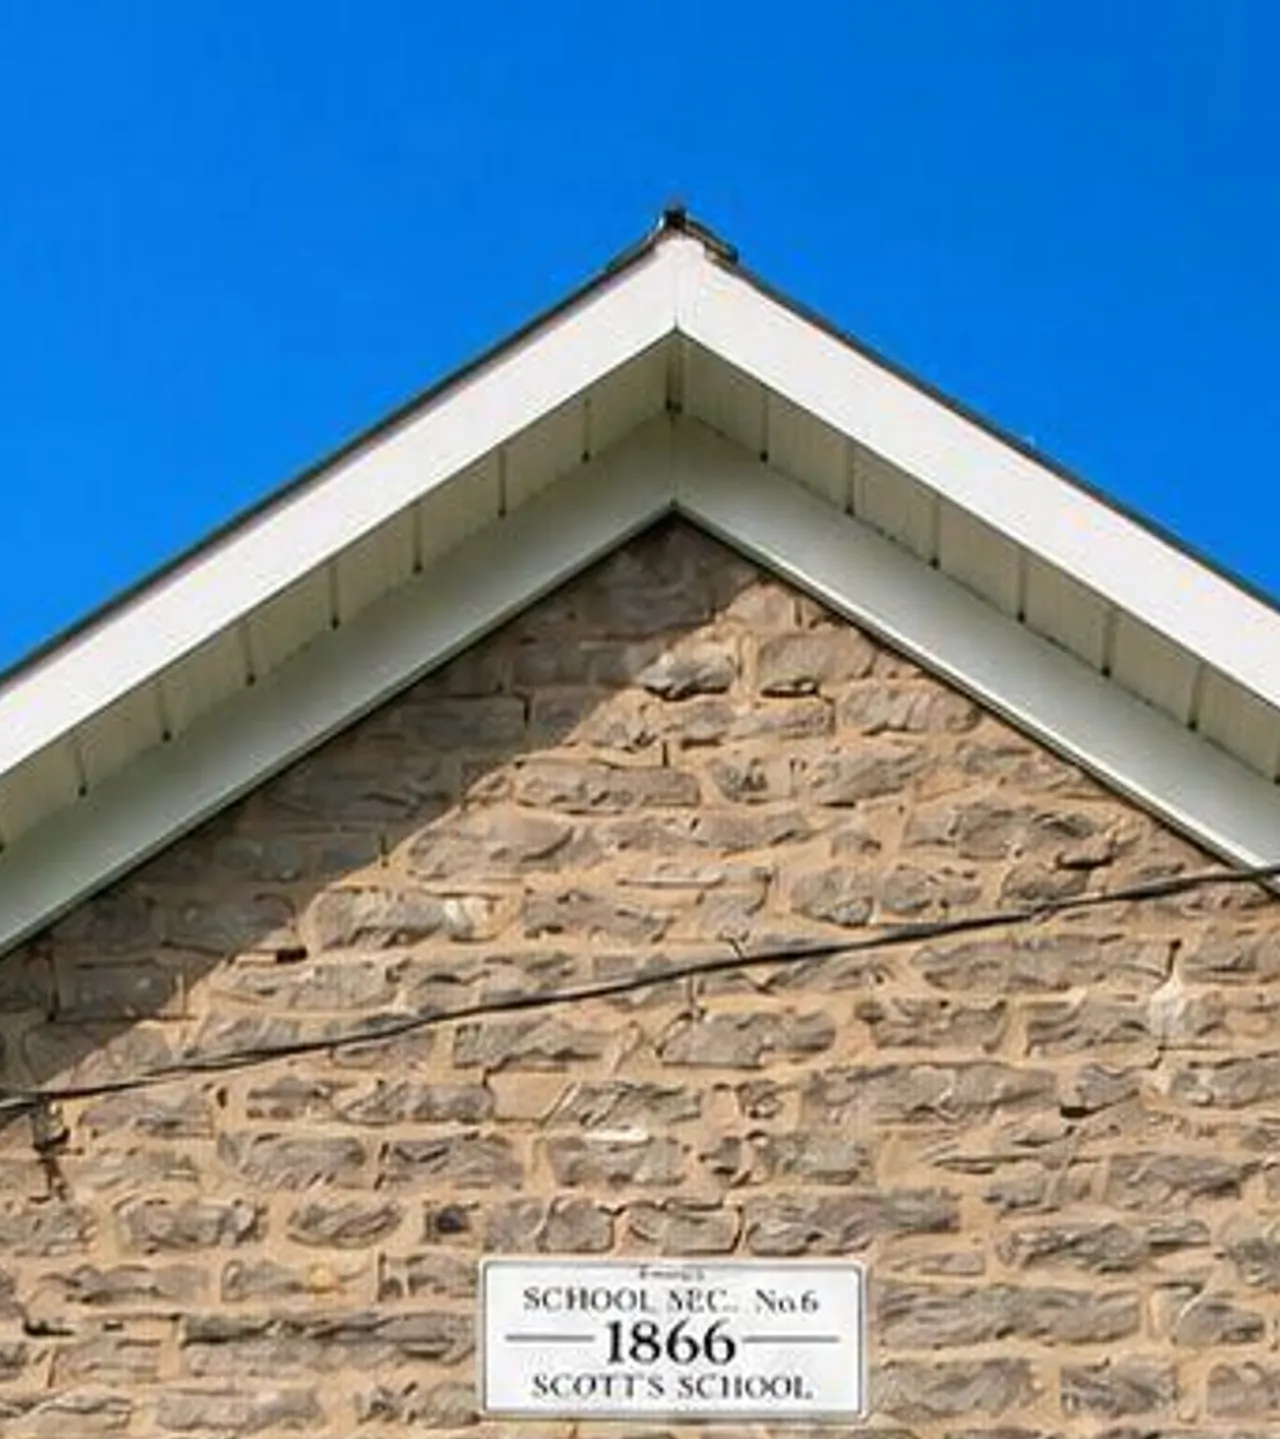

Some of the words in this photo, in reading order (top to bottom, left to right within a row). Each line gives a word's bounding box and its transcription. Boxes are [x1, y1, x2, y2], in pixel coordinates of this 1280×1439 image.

[522, 1285, 657, 1313] SCHOOL
[606, 1320, 737, 1366] 1866
[676, 1372, 814, 1400] SCHOOL
